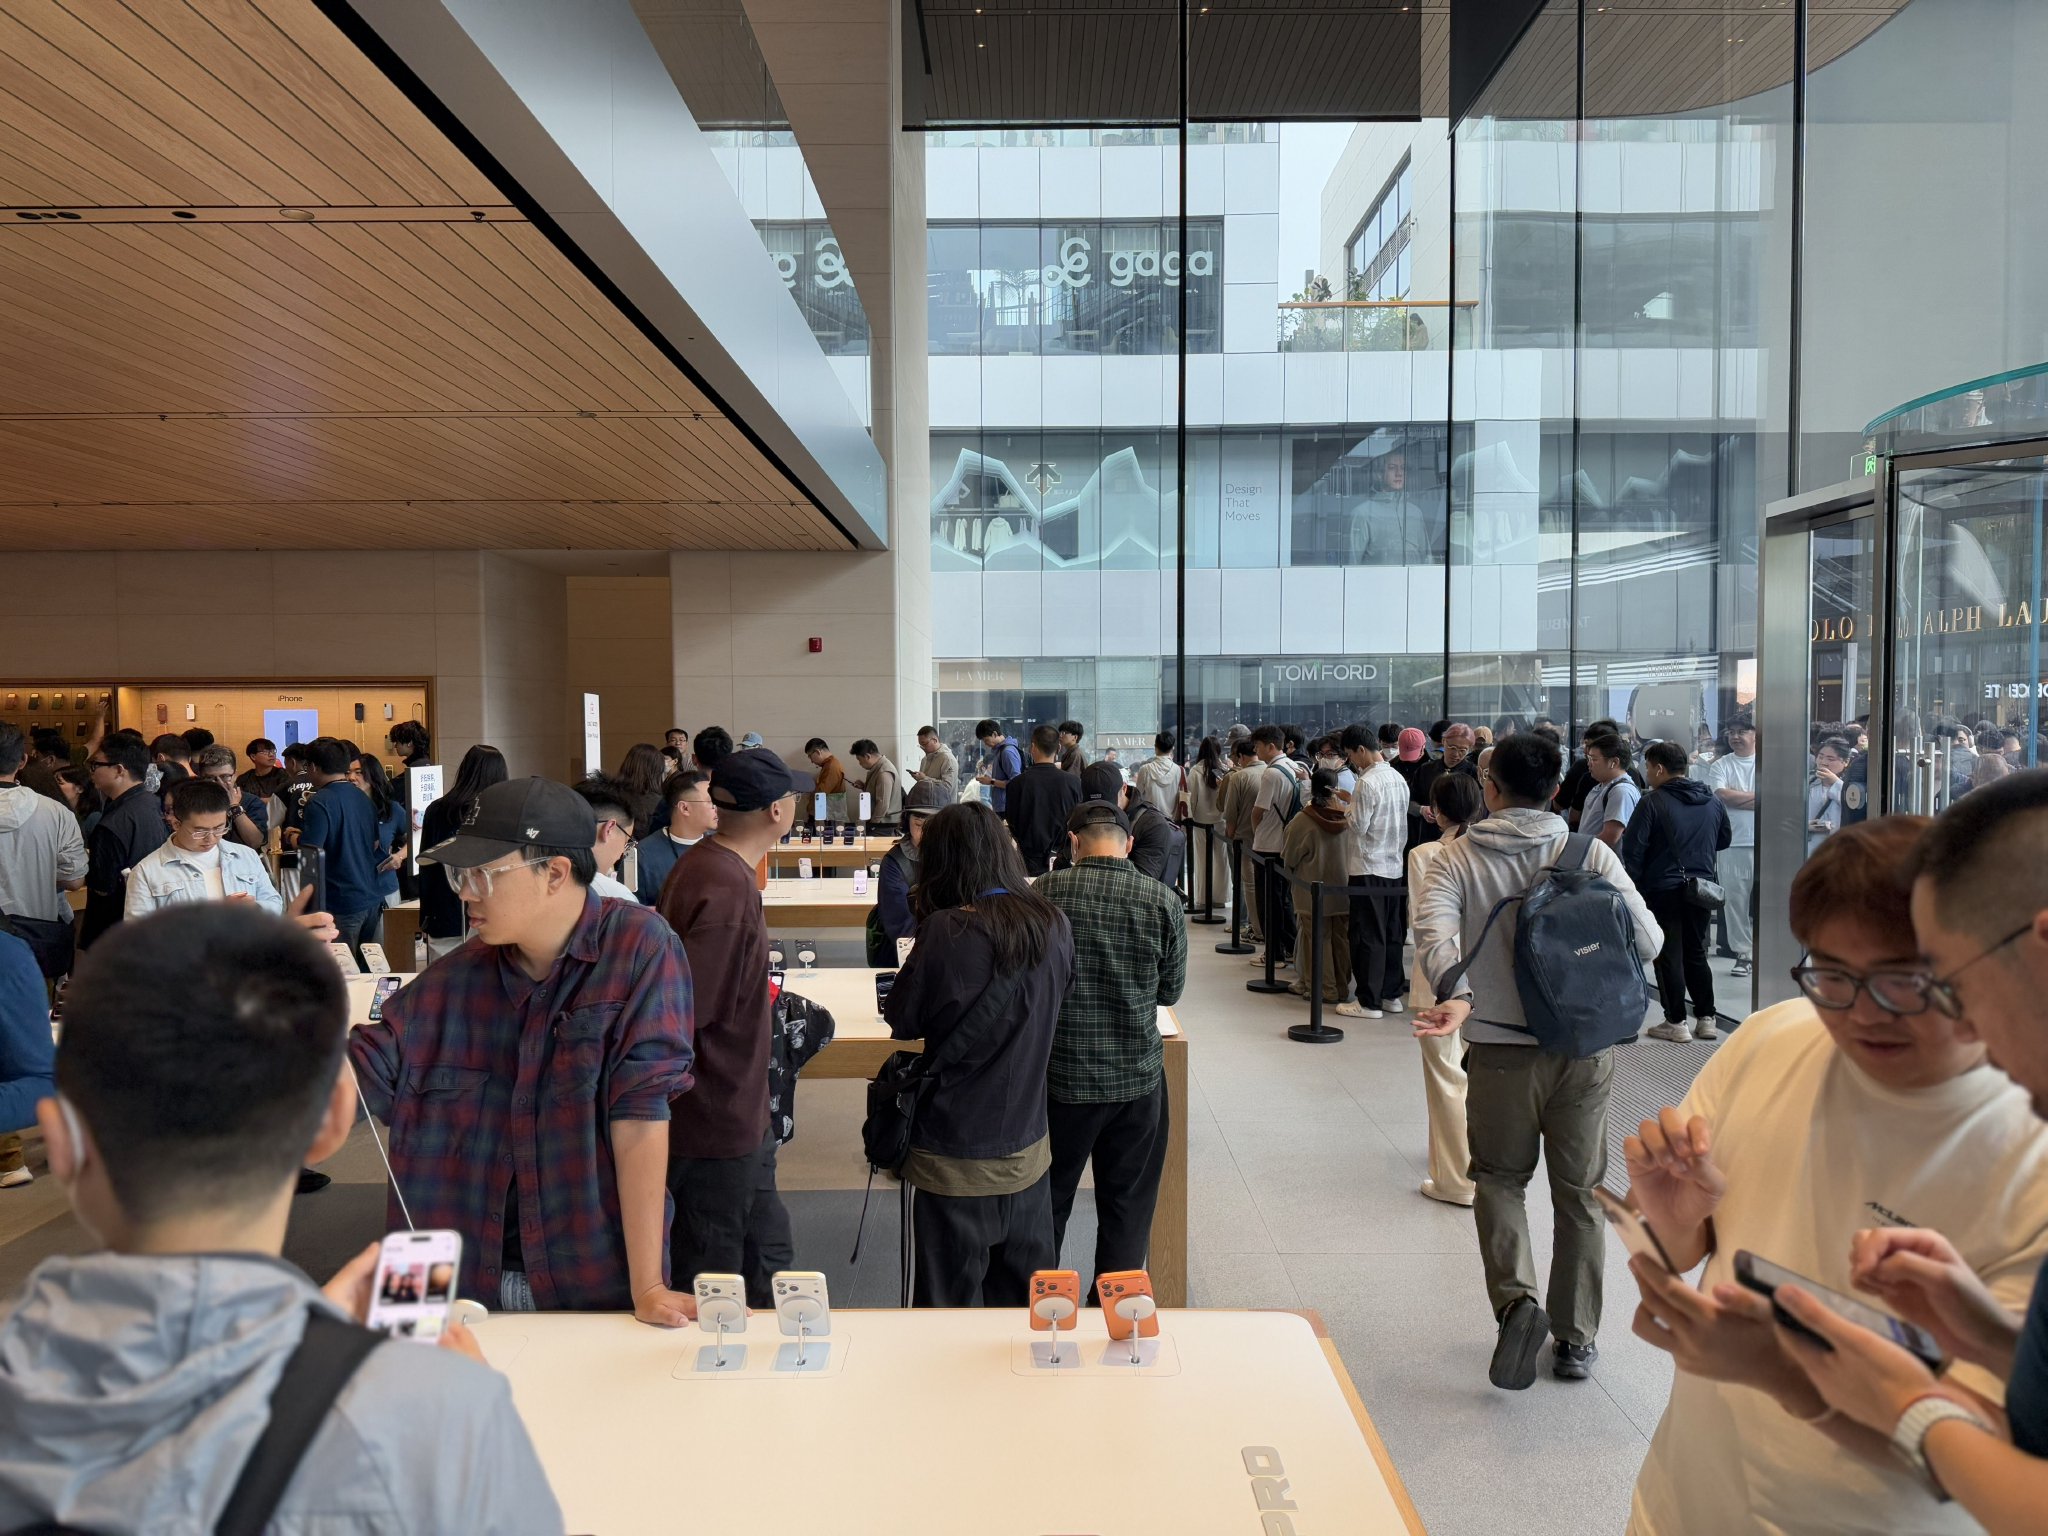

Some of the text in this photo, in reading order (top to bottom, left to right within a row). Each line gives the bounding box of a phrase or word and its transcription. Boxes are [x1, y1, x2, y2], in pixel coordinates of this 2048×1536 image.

[1109, 250, 1213, 287] gaga
[1225, 483, 1262, 496] Design
[1224, 497, 1250, 508] That
[1225, 511, 1261, 521] Moves
[1273, 664, 1377, 681] TOM FORD
[277, 694, 304, 702] iPhone
[1107, 737, 1146, 746] LA MER
[1573, 941, 1600, 957] visier
[1240, 1445, 1299, 1536] PRO
